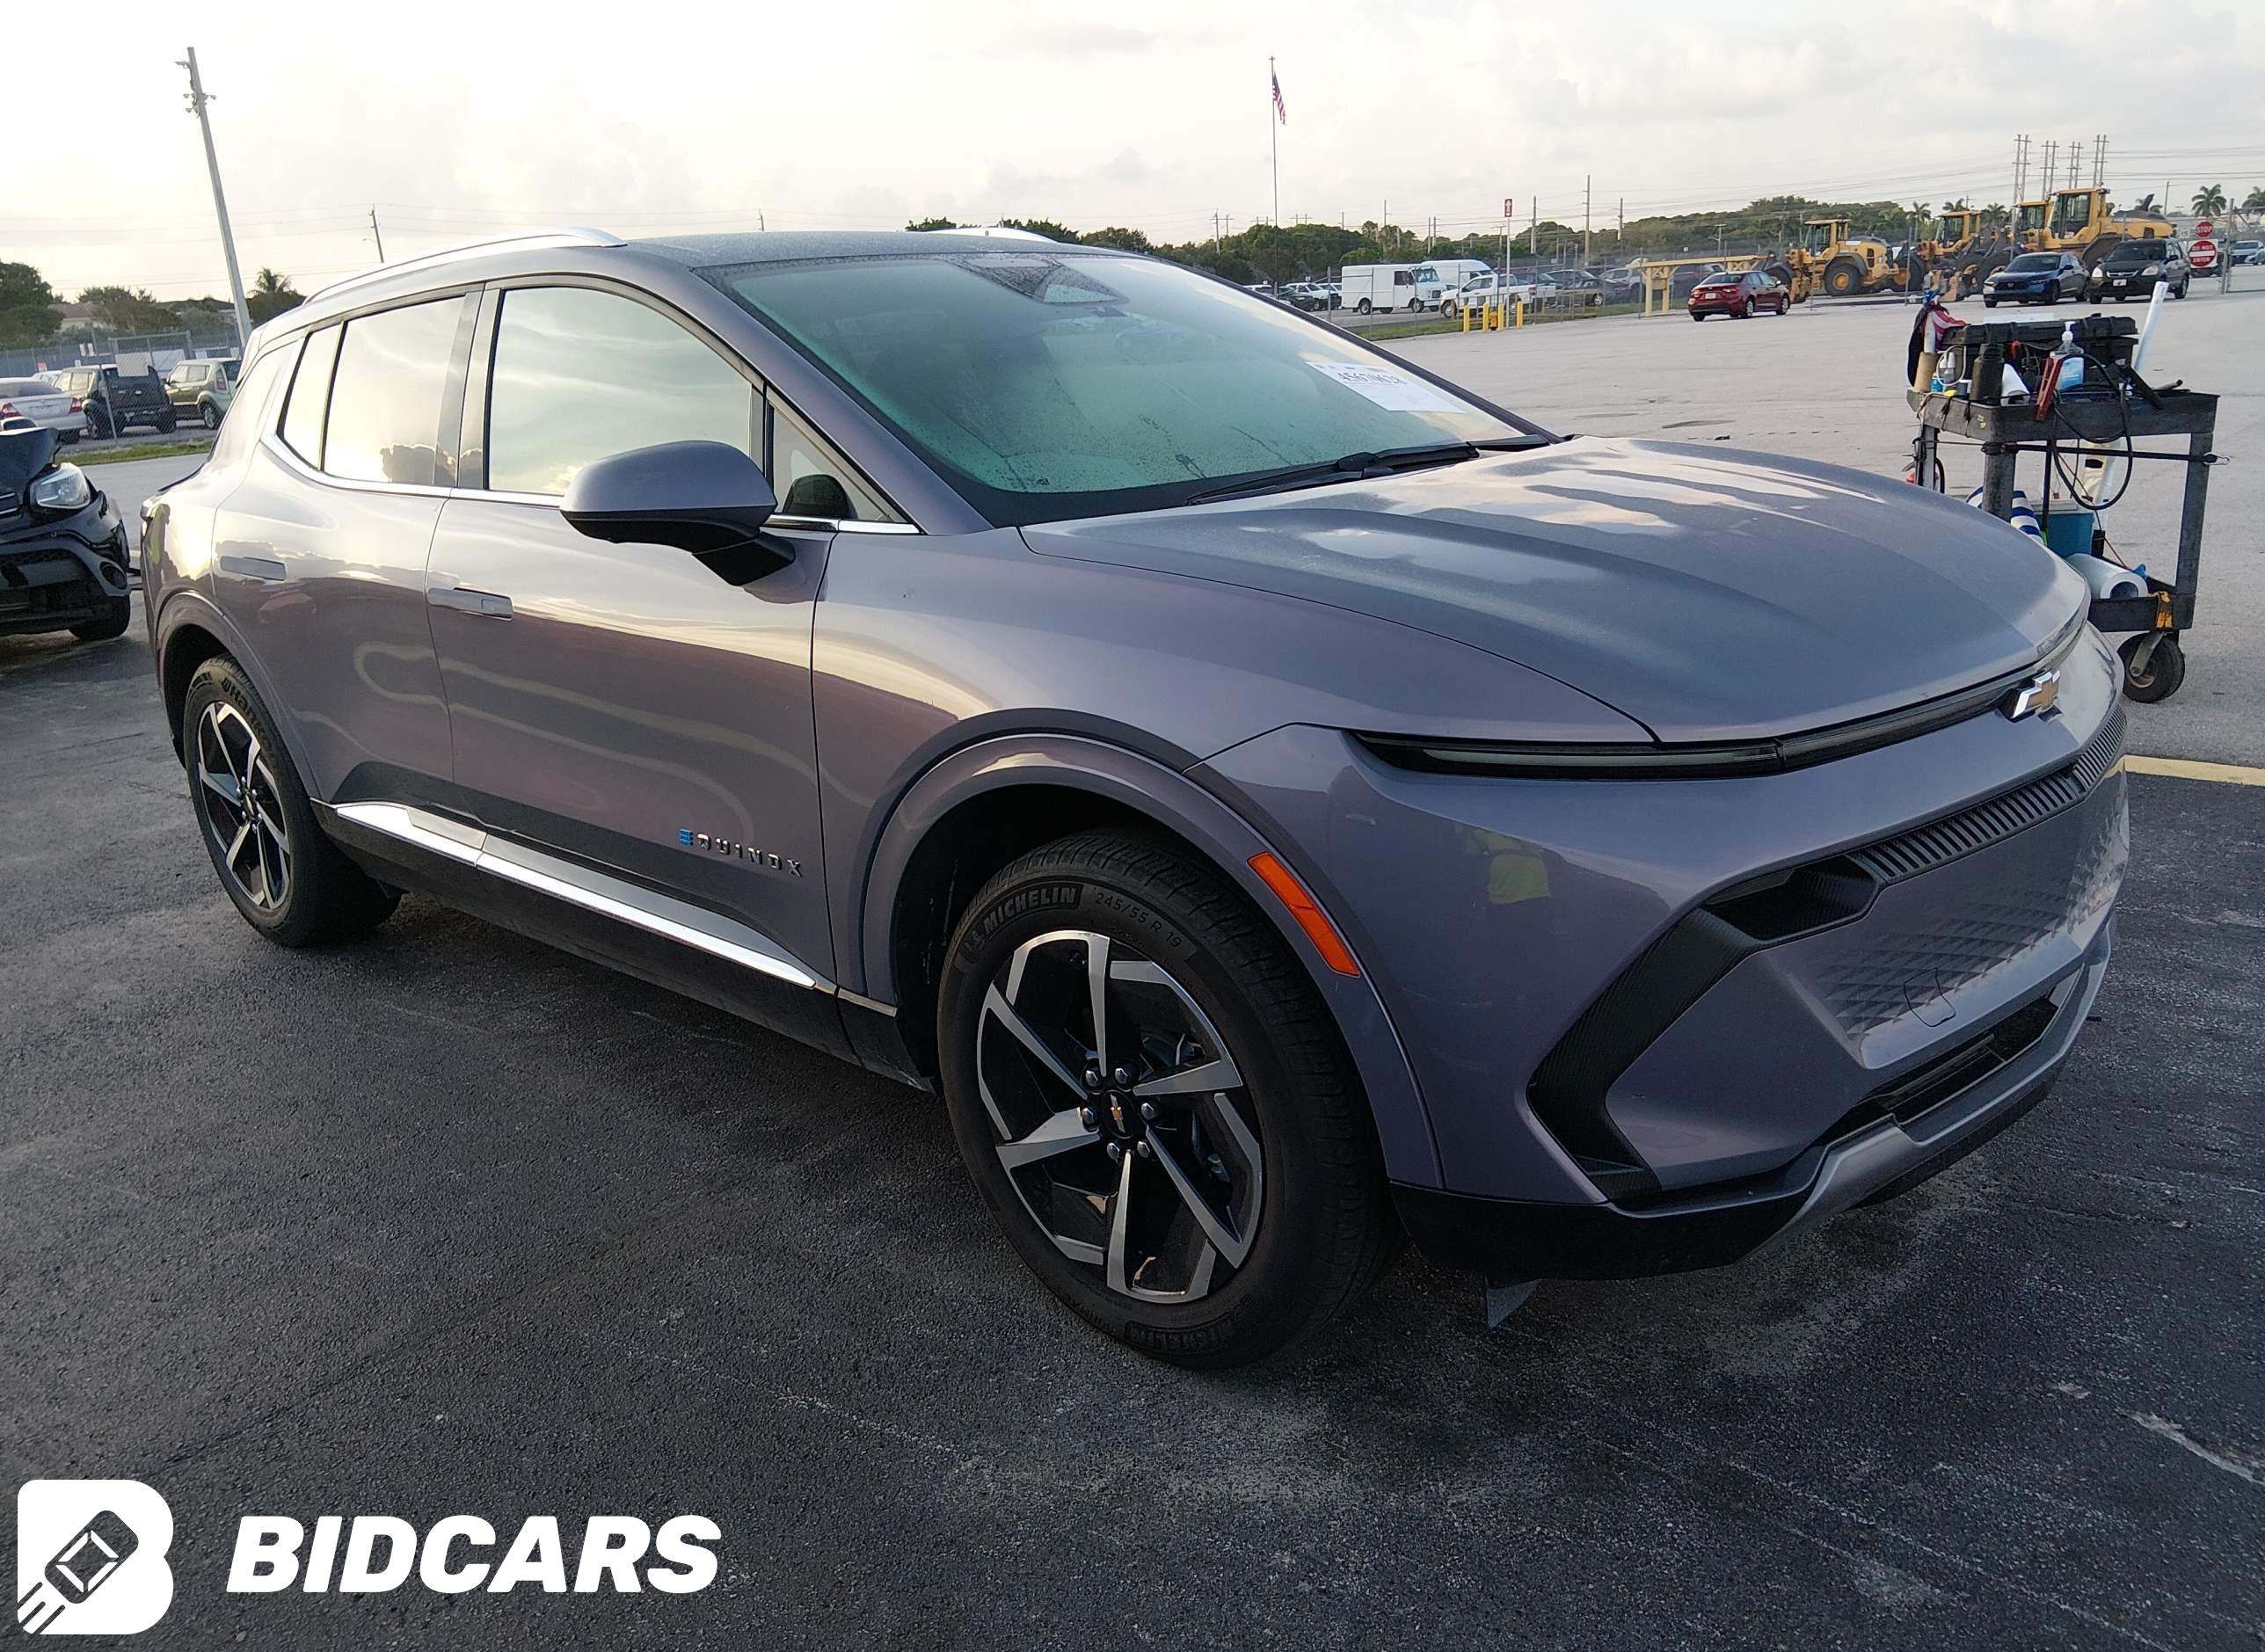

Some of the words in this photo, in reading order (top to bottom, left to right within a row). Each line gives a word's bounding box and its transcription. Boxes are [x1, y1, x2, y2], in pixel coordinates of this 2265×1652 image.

[2196, 225, 2213, 234] STOP
[679, 829, 803, 878] EQUINOX
[983, 886, 1076, 935] MICHELIN
[1095, 892, 1148, 923] 245/55
[1150, 921, 1162, 934] R
[1166, 932, 1182, 948] 19
